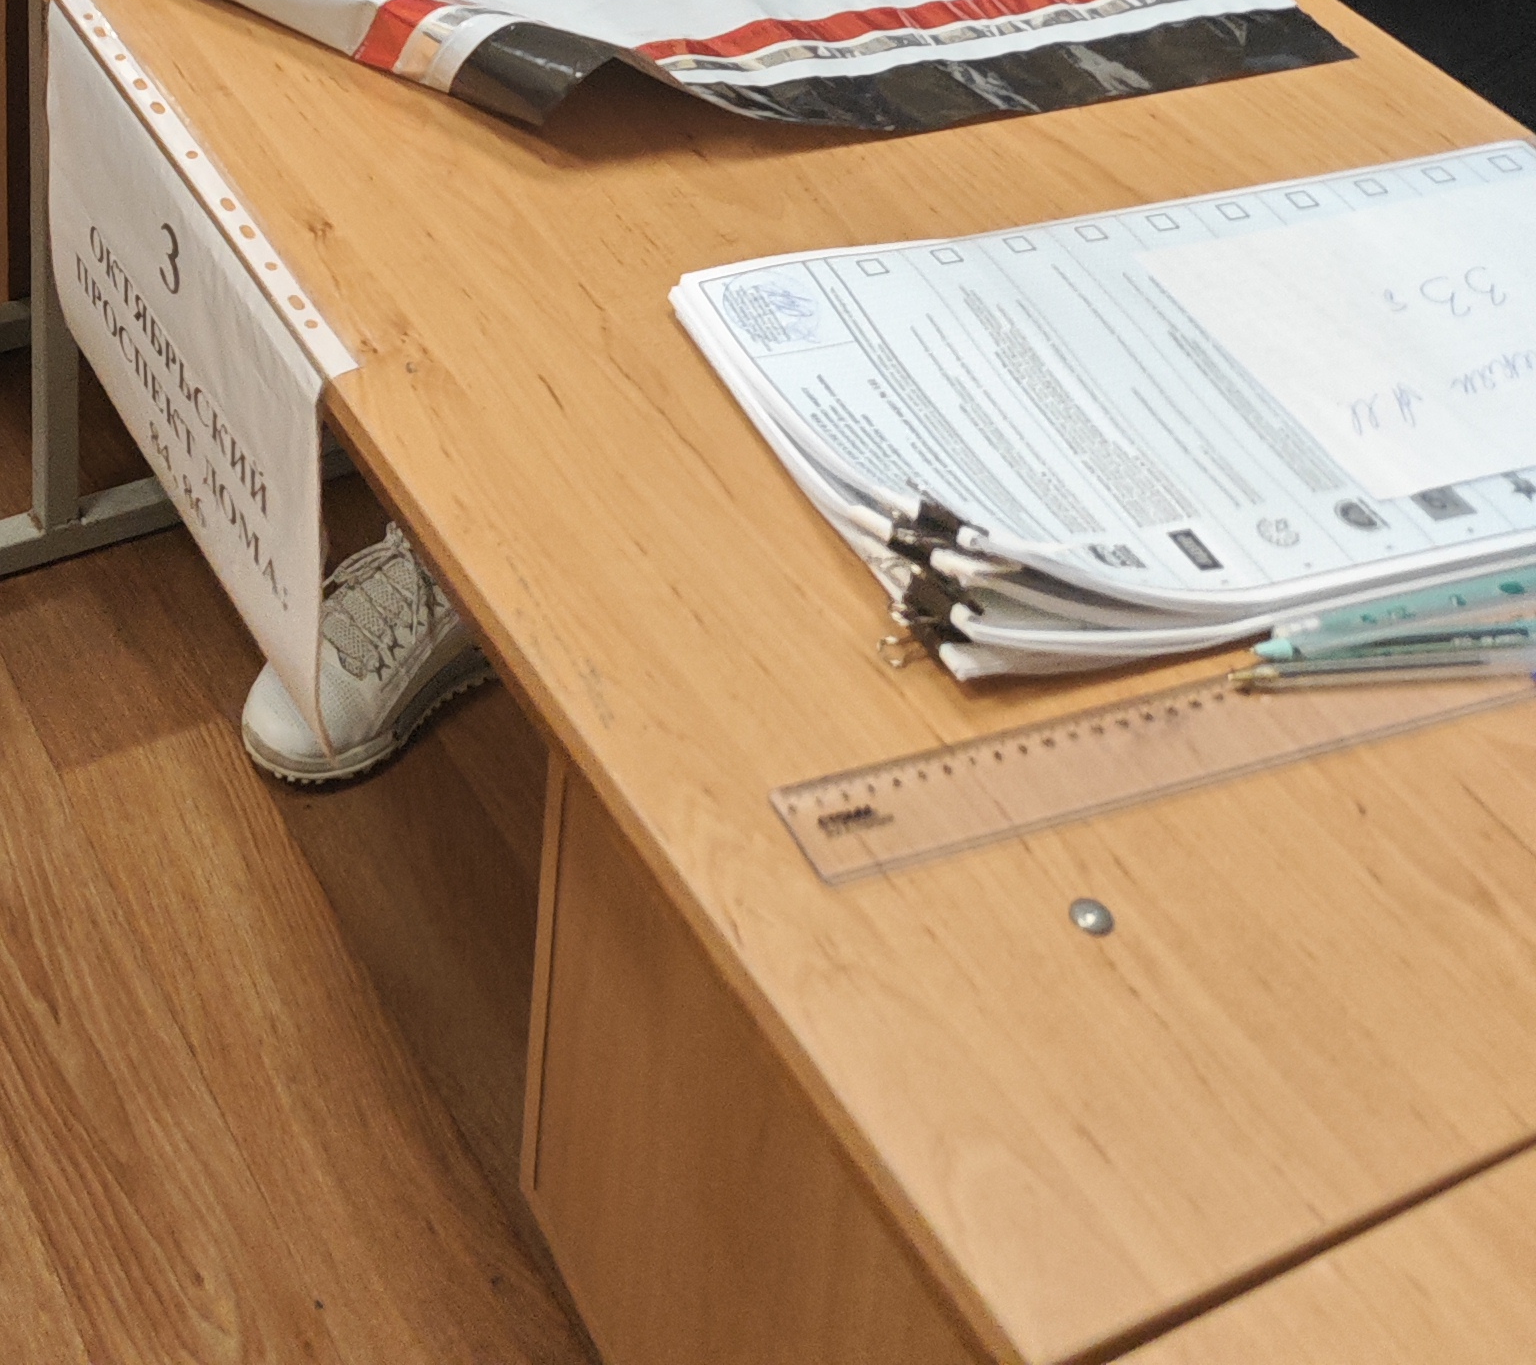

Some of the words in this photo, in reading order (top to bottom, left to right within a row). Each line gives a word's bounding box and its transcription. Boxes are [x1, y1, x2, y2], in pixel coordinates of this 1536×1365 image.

[74, 251, 198, 456] ПРОСПЕКТ
[158, 222, 181, 296] 3
[90, 224, 270, 520] ОКТЯБРЬСКИЙ
